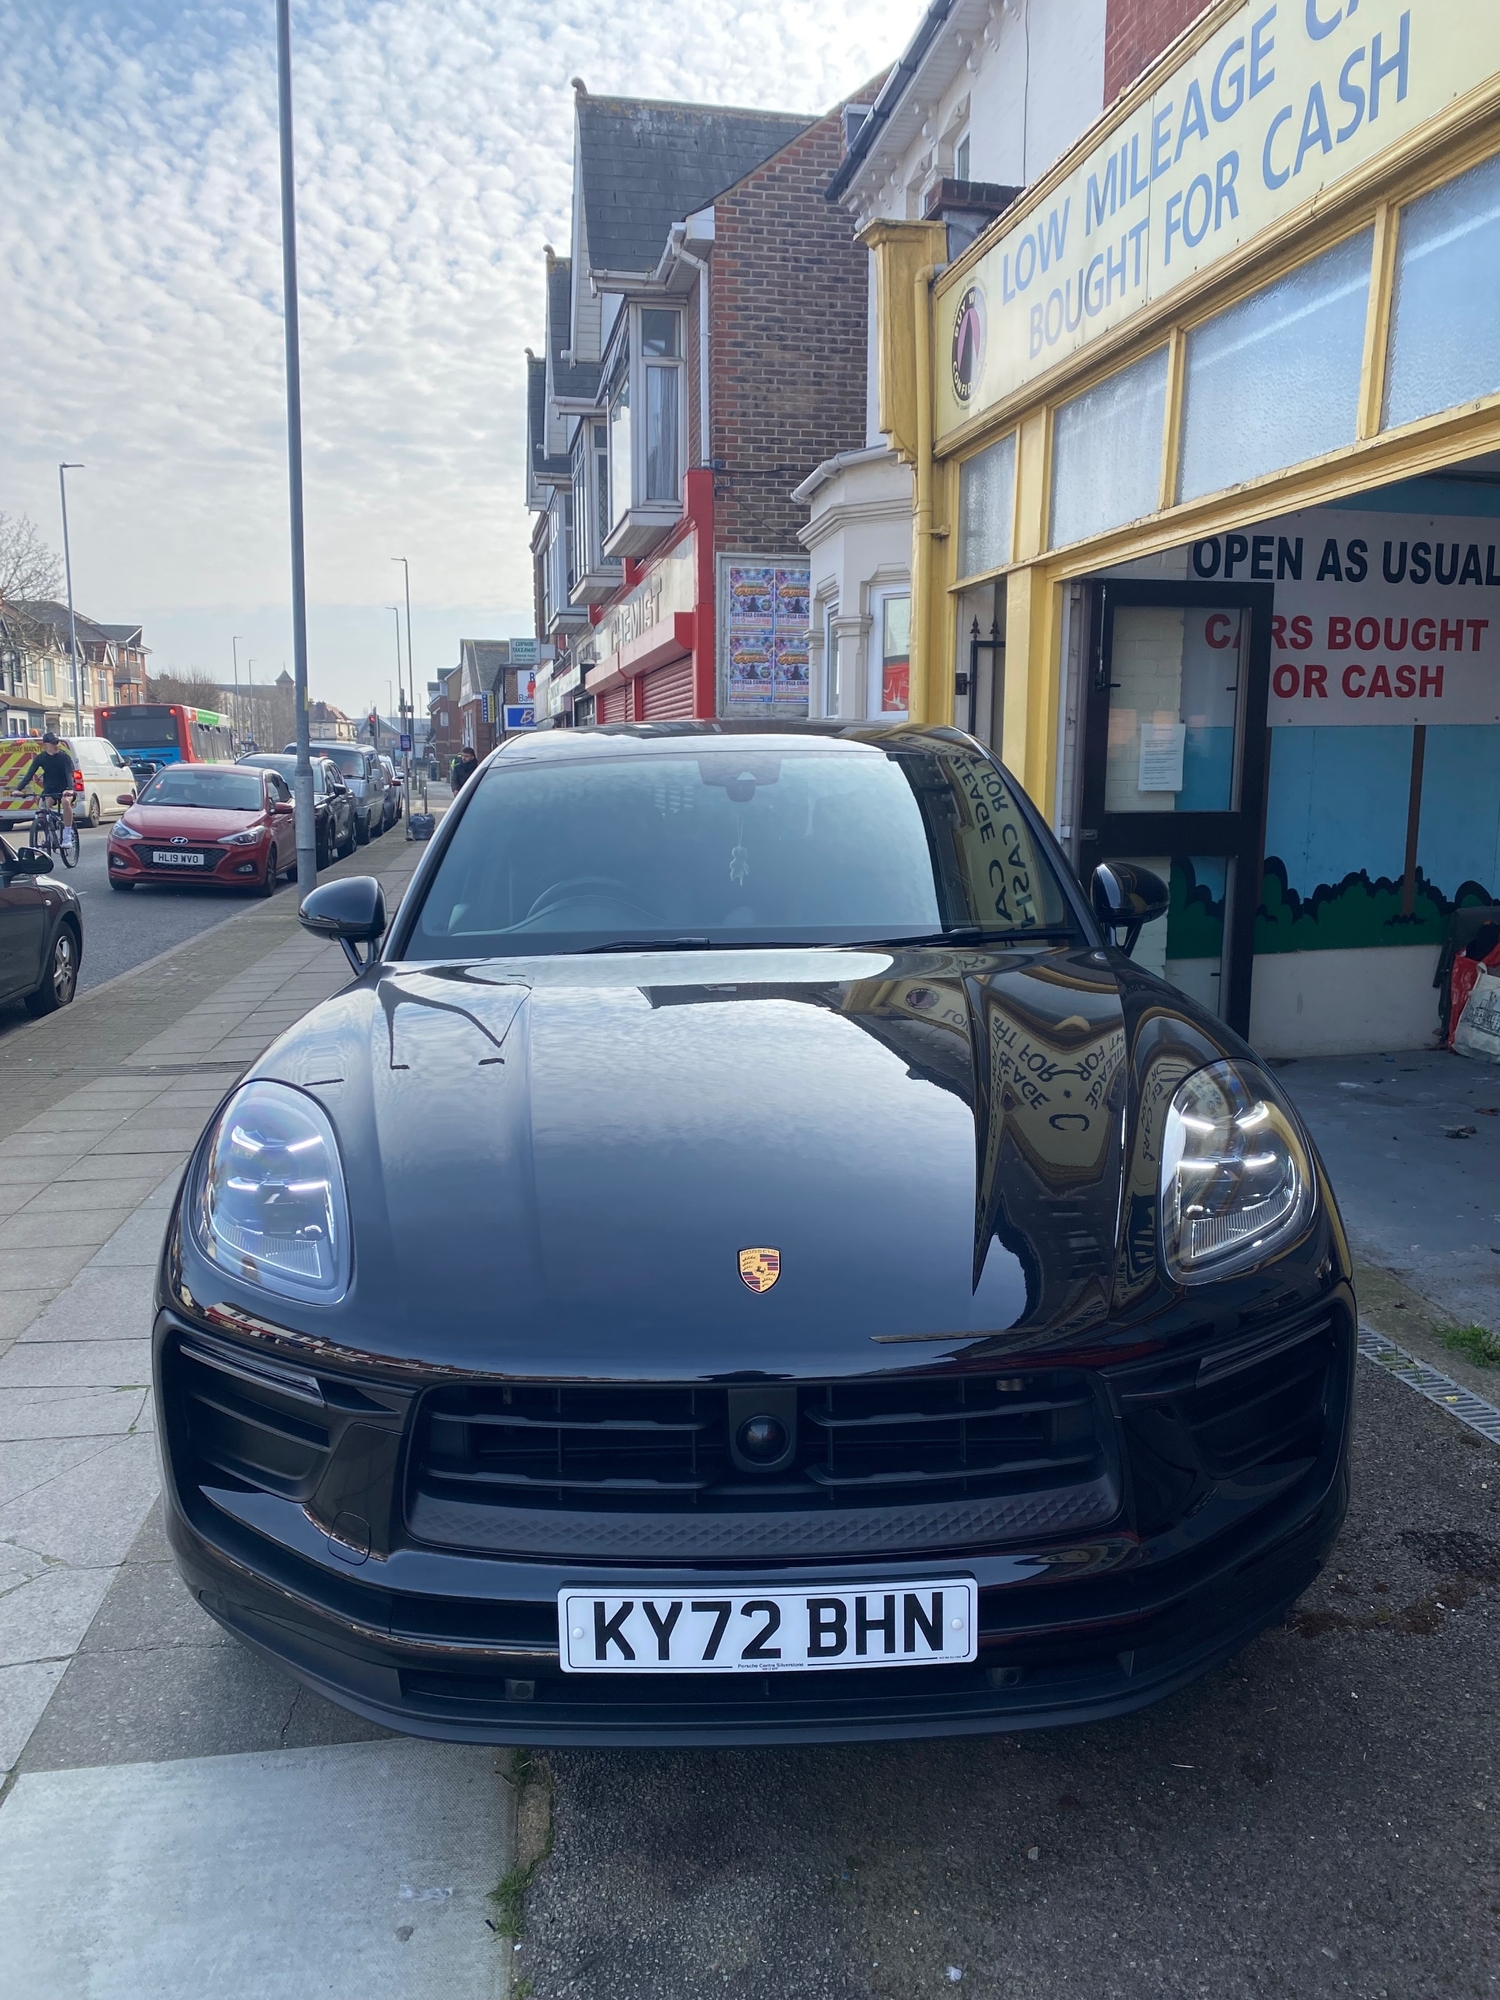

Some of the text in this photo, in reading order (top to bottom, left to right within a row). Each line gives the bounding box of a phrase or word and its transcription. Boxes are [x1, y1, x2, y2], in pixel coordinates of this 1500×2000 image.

[1002, 197, 1071, 304] LOW
[1084, 6, 1277, 238] MILEAGE
[1029, 8, 1411, 360] BOUGHT FOR CASH
[1192, 534, 1500, 586] OPEN AS USUAL
[610, 577, 662, 655] CHEMIST
[1327, 616, 1489, 652] BOUGHT
[1272, 663, 1444, 699] OR CASH
[158, 853, 199, 864] HL19 WVO
[593, 1591, 944, 1661] KY72 BHN
